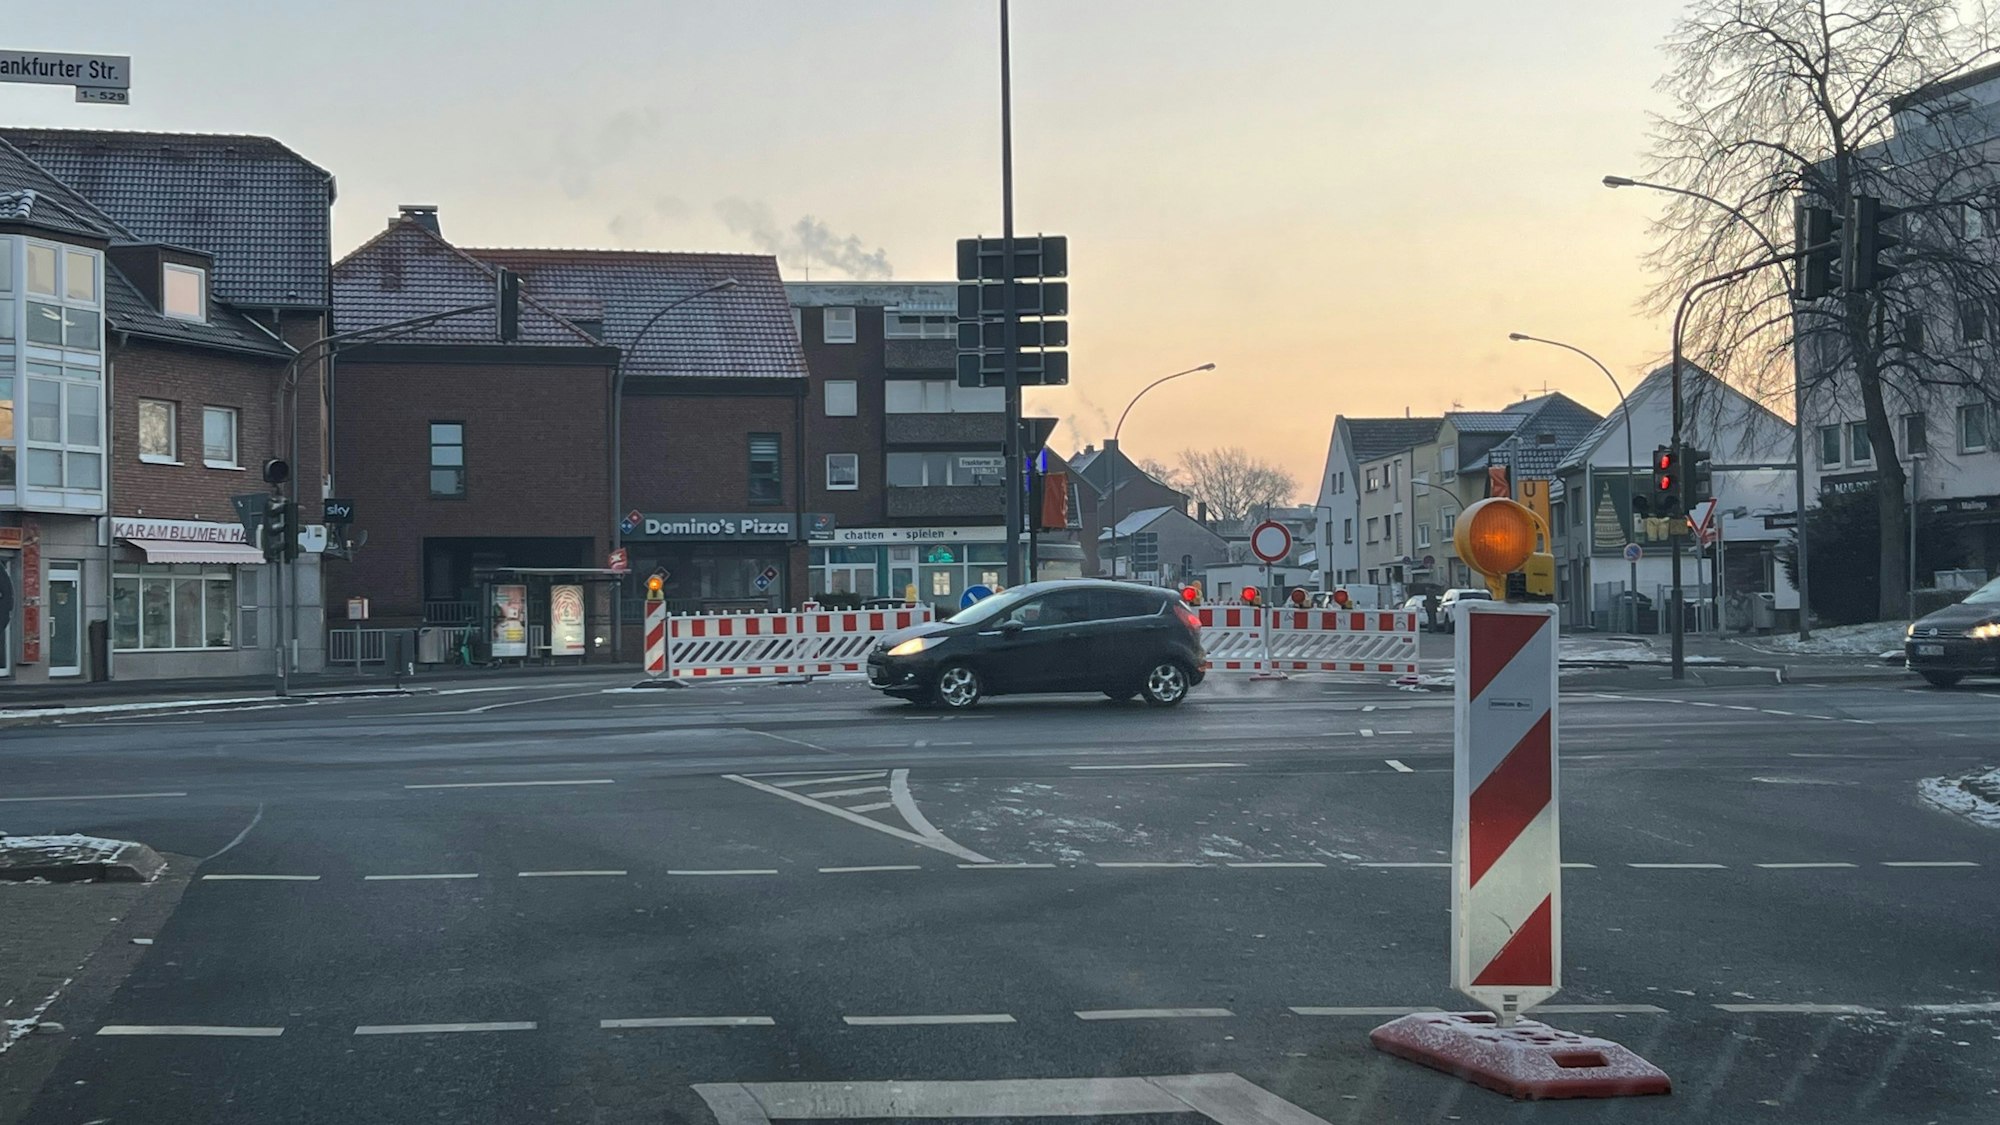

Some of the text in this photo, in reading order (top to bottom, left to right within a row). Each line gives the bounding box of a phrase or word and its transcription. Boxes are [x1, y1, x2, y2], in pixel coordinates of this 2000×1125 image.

[0, 56, 119, 80] ankfurter Str.
[100, 92, 126, 101] 529
[327, 504, 350, 518] sky
[114, 523, 168, 539] KARAM
[170, 525, 227, 542] BLUMEN
[645, 518, 789, 535] Domino's Pizza
[844, 530, 884, 540] chatten
[906, 529, 945, 541] spielen
